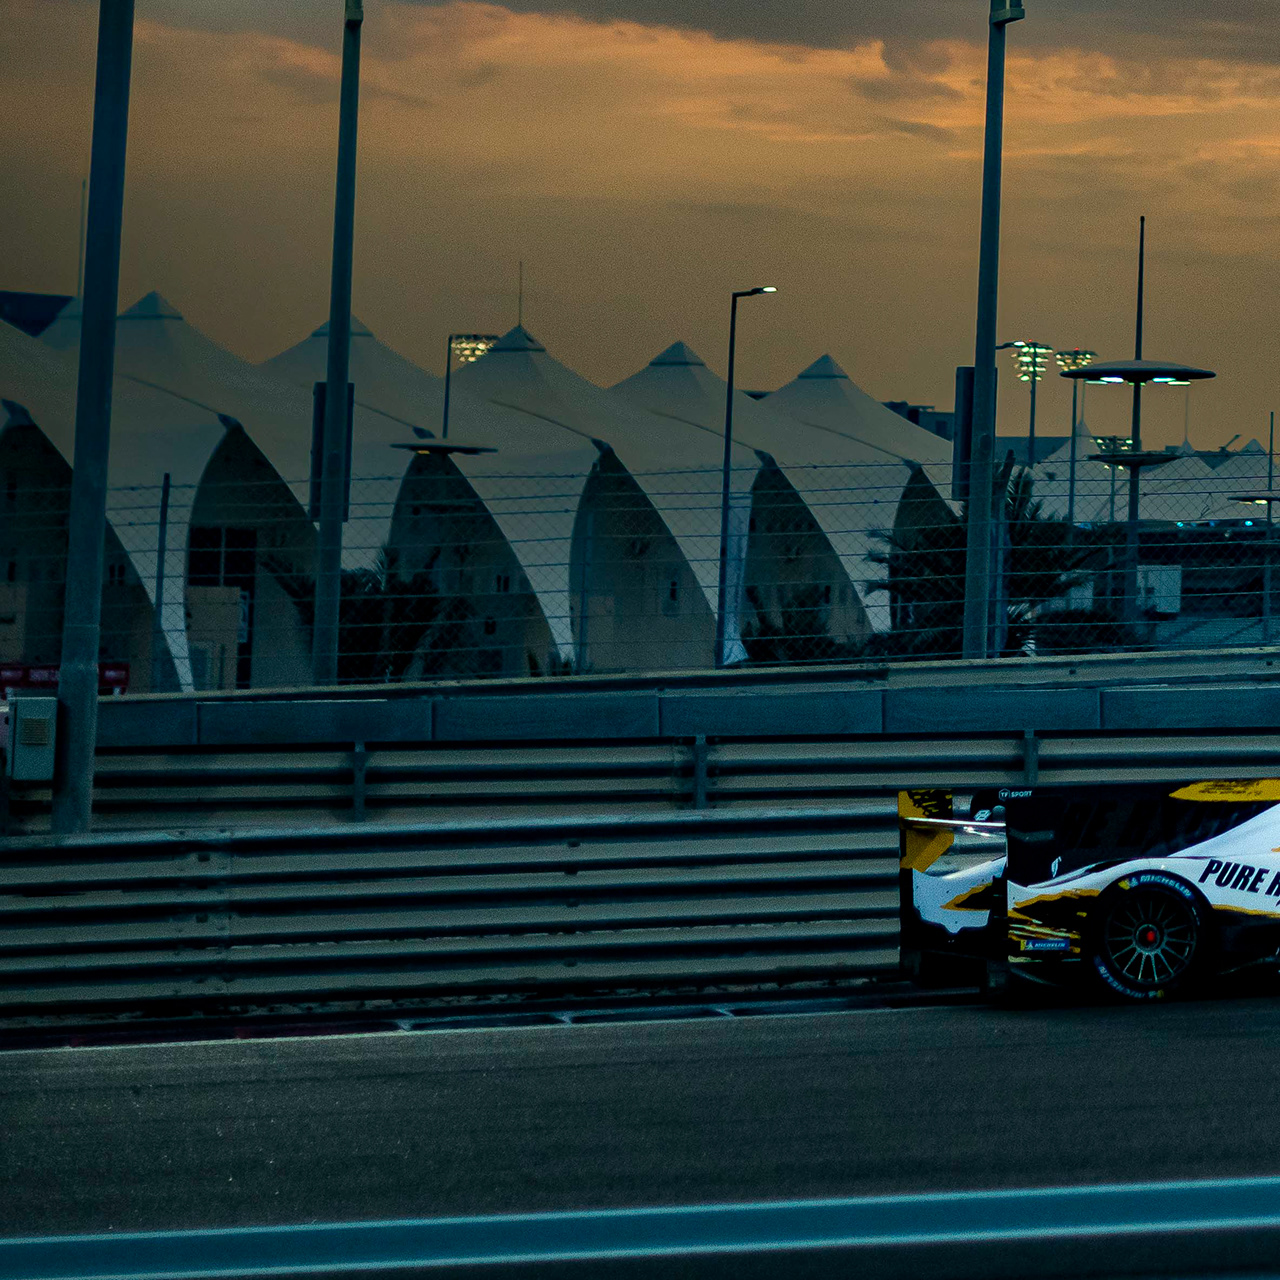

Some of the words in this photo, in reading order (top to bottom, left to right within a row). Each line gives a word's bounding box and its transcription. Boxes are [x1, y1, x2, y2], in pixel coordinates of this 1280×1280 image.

[1011, 790, 1033, 798] SPORT
[1140, 874, 1193, 899] MICHELIN
[1198, 858, 1270, 894] PURE
